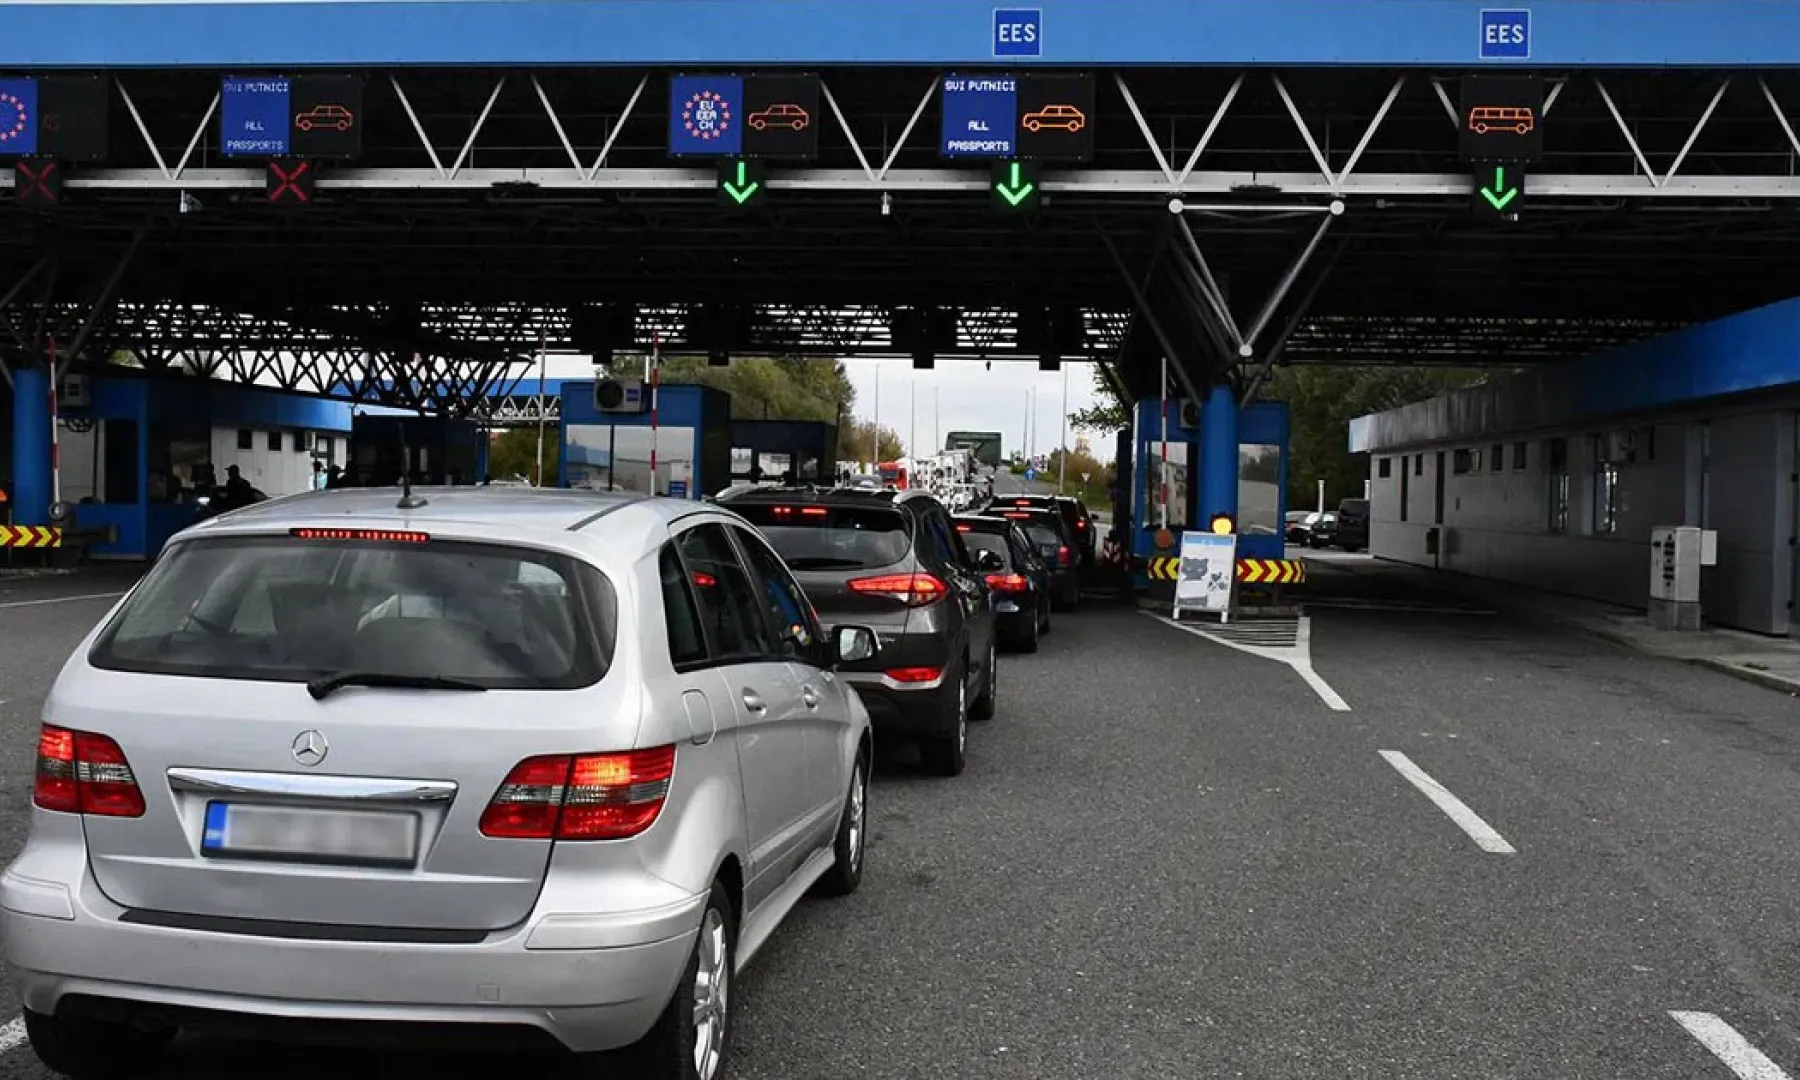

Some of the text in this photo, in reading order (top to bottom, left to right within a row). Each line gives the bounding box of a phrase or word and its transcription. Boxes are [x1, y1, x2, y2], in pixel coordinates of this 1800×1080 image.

[999, 23, 1035, 42] EES
[1486, 24, 1524, 44] EES
[245, 82, 288, 92] PUTNICI
[968, 81, 1015, 91] PUTNICI
[699, 101, 714, 110] EU
[245, 121, 264, 131] ALL
[968, 121, 989, 131] ALL
[227, 140, 283, 150] PASSPORTS
[948, 140, 1009, 151] PASSPORTS
